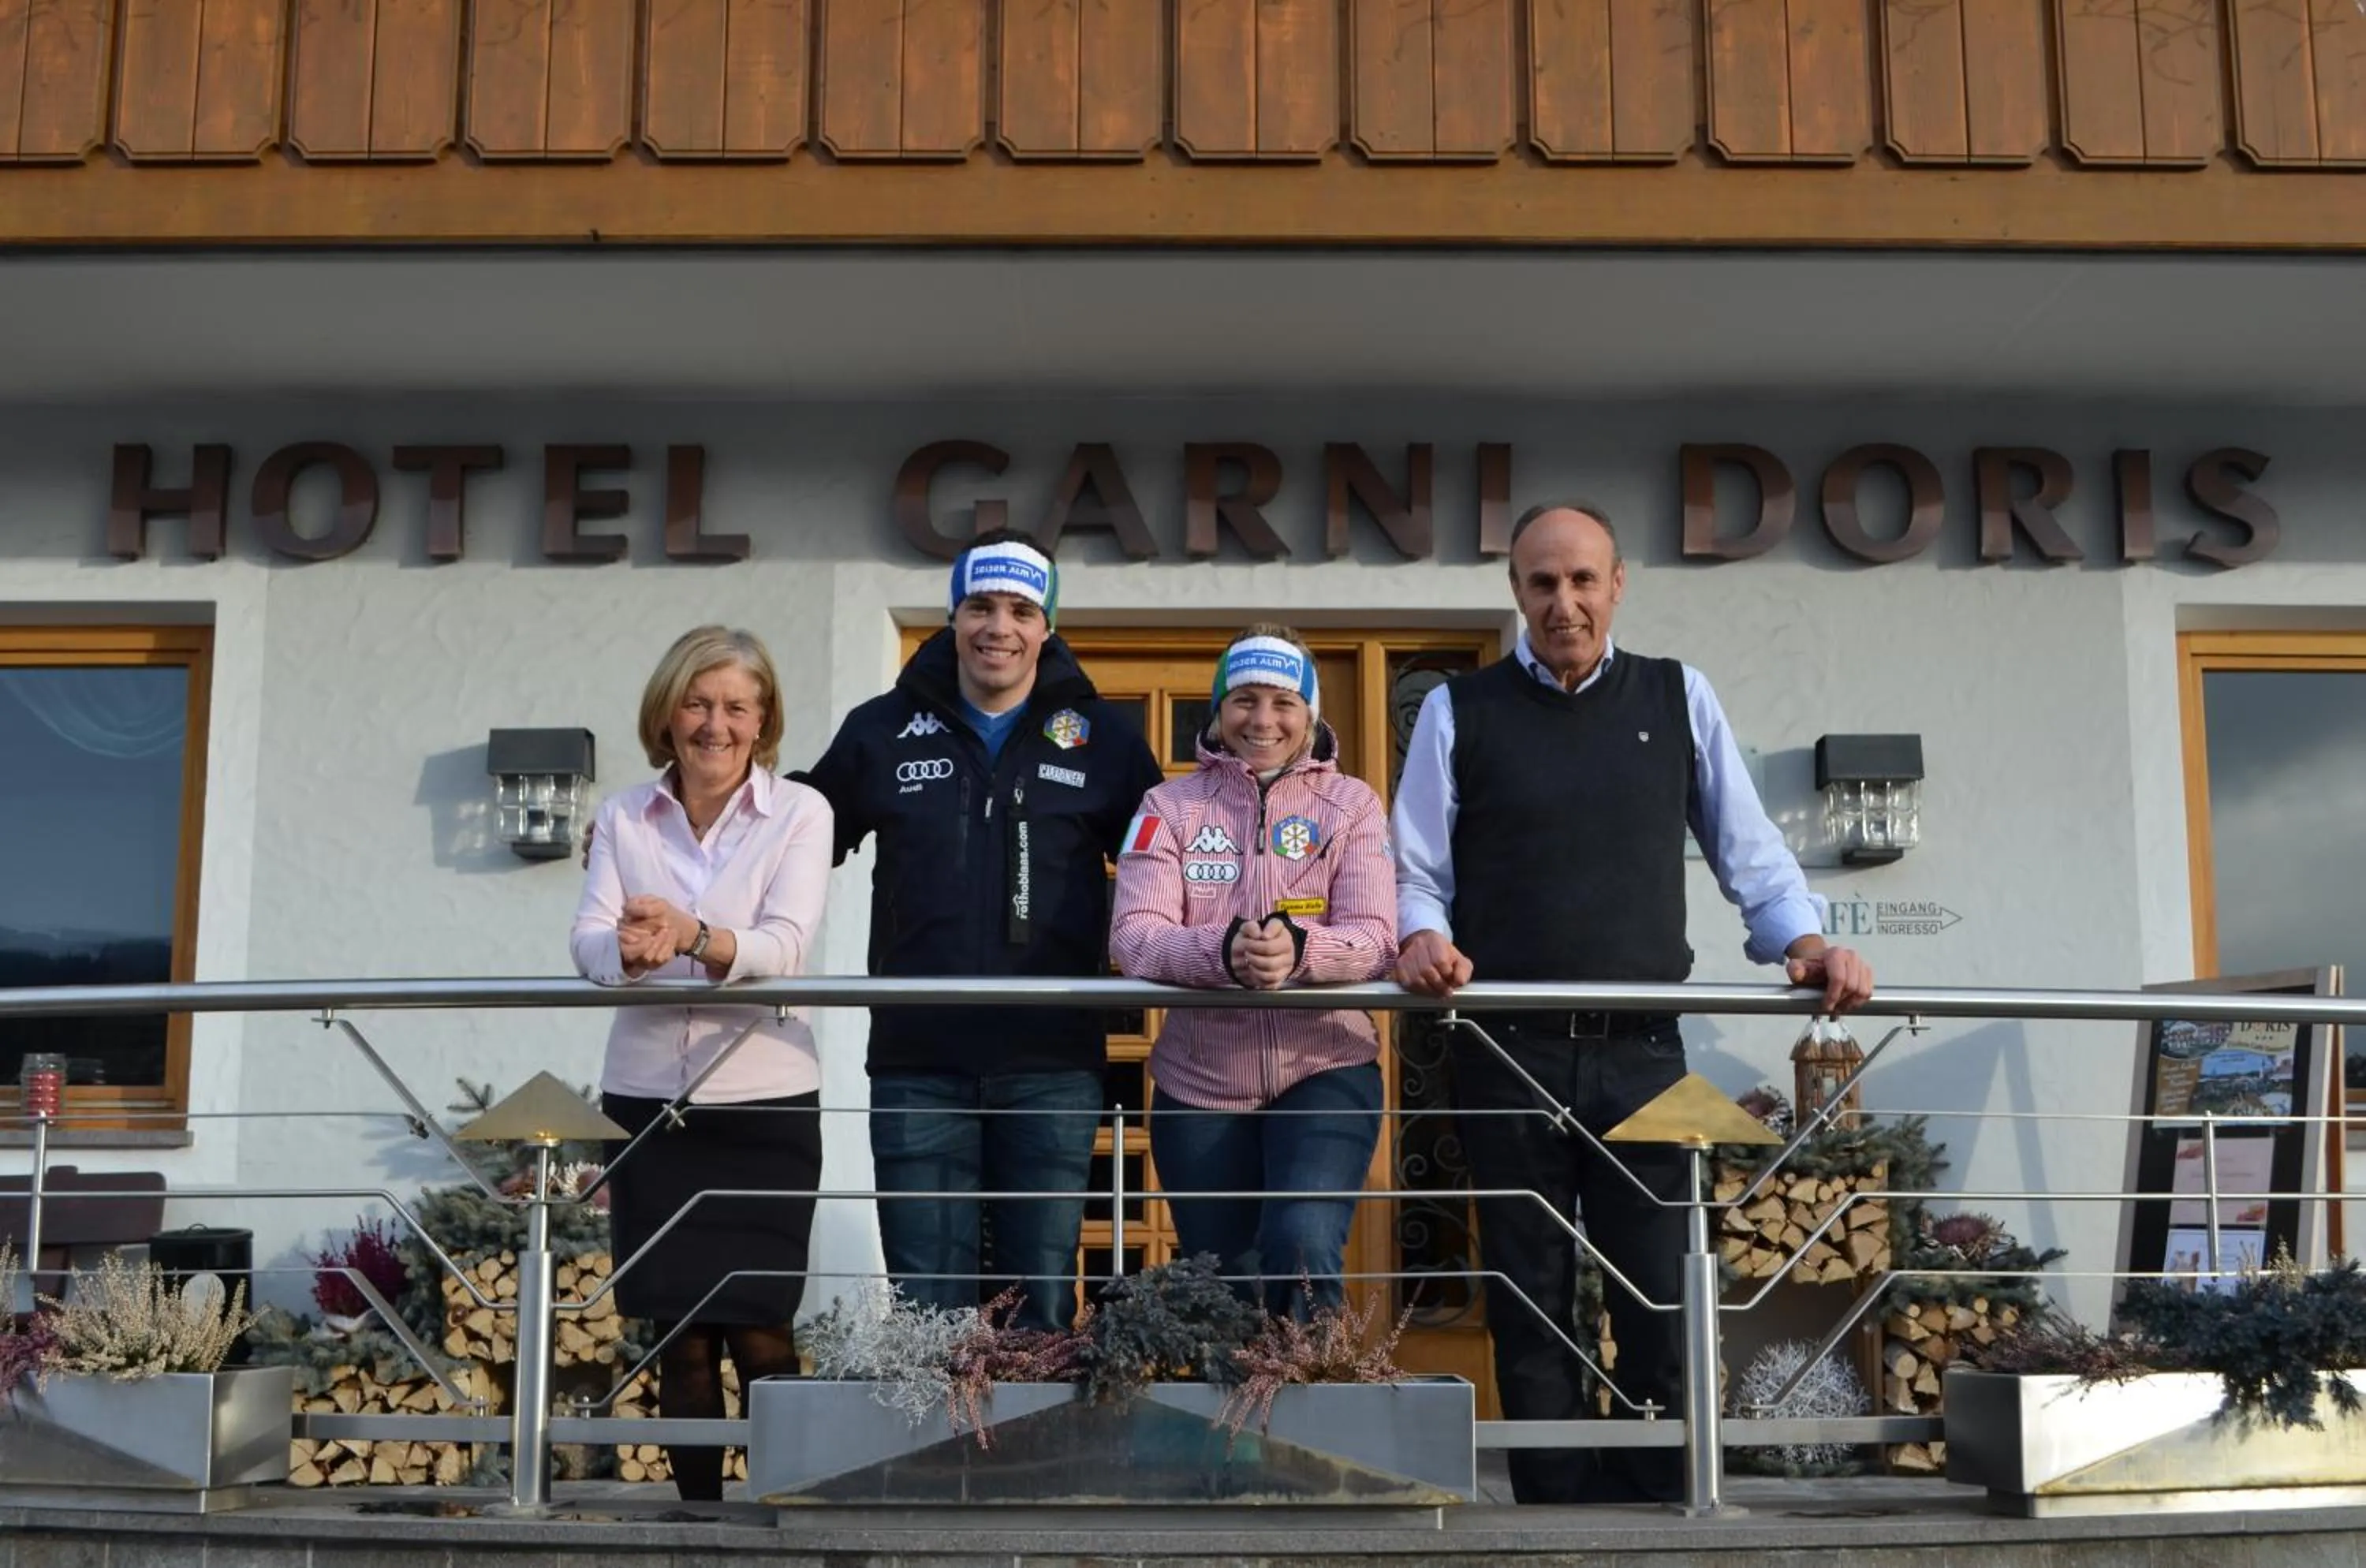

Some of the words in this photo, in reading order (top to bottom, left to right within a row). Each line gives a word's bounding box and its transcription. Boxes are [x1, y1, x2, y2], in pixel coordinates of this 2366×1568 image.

[108, 440, 751, 562] HOTEL
[892, 439, 1512, 562] GARNI
[1680, 442, 2282, 569] DORIS
[899, 783, 923, 793] Audi
[1822, 891, 1872, 935] FÈ
[1877, 902, 1936, 913] EINGANG
[1878, 924, 1938, 935] INGRESSO
